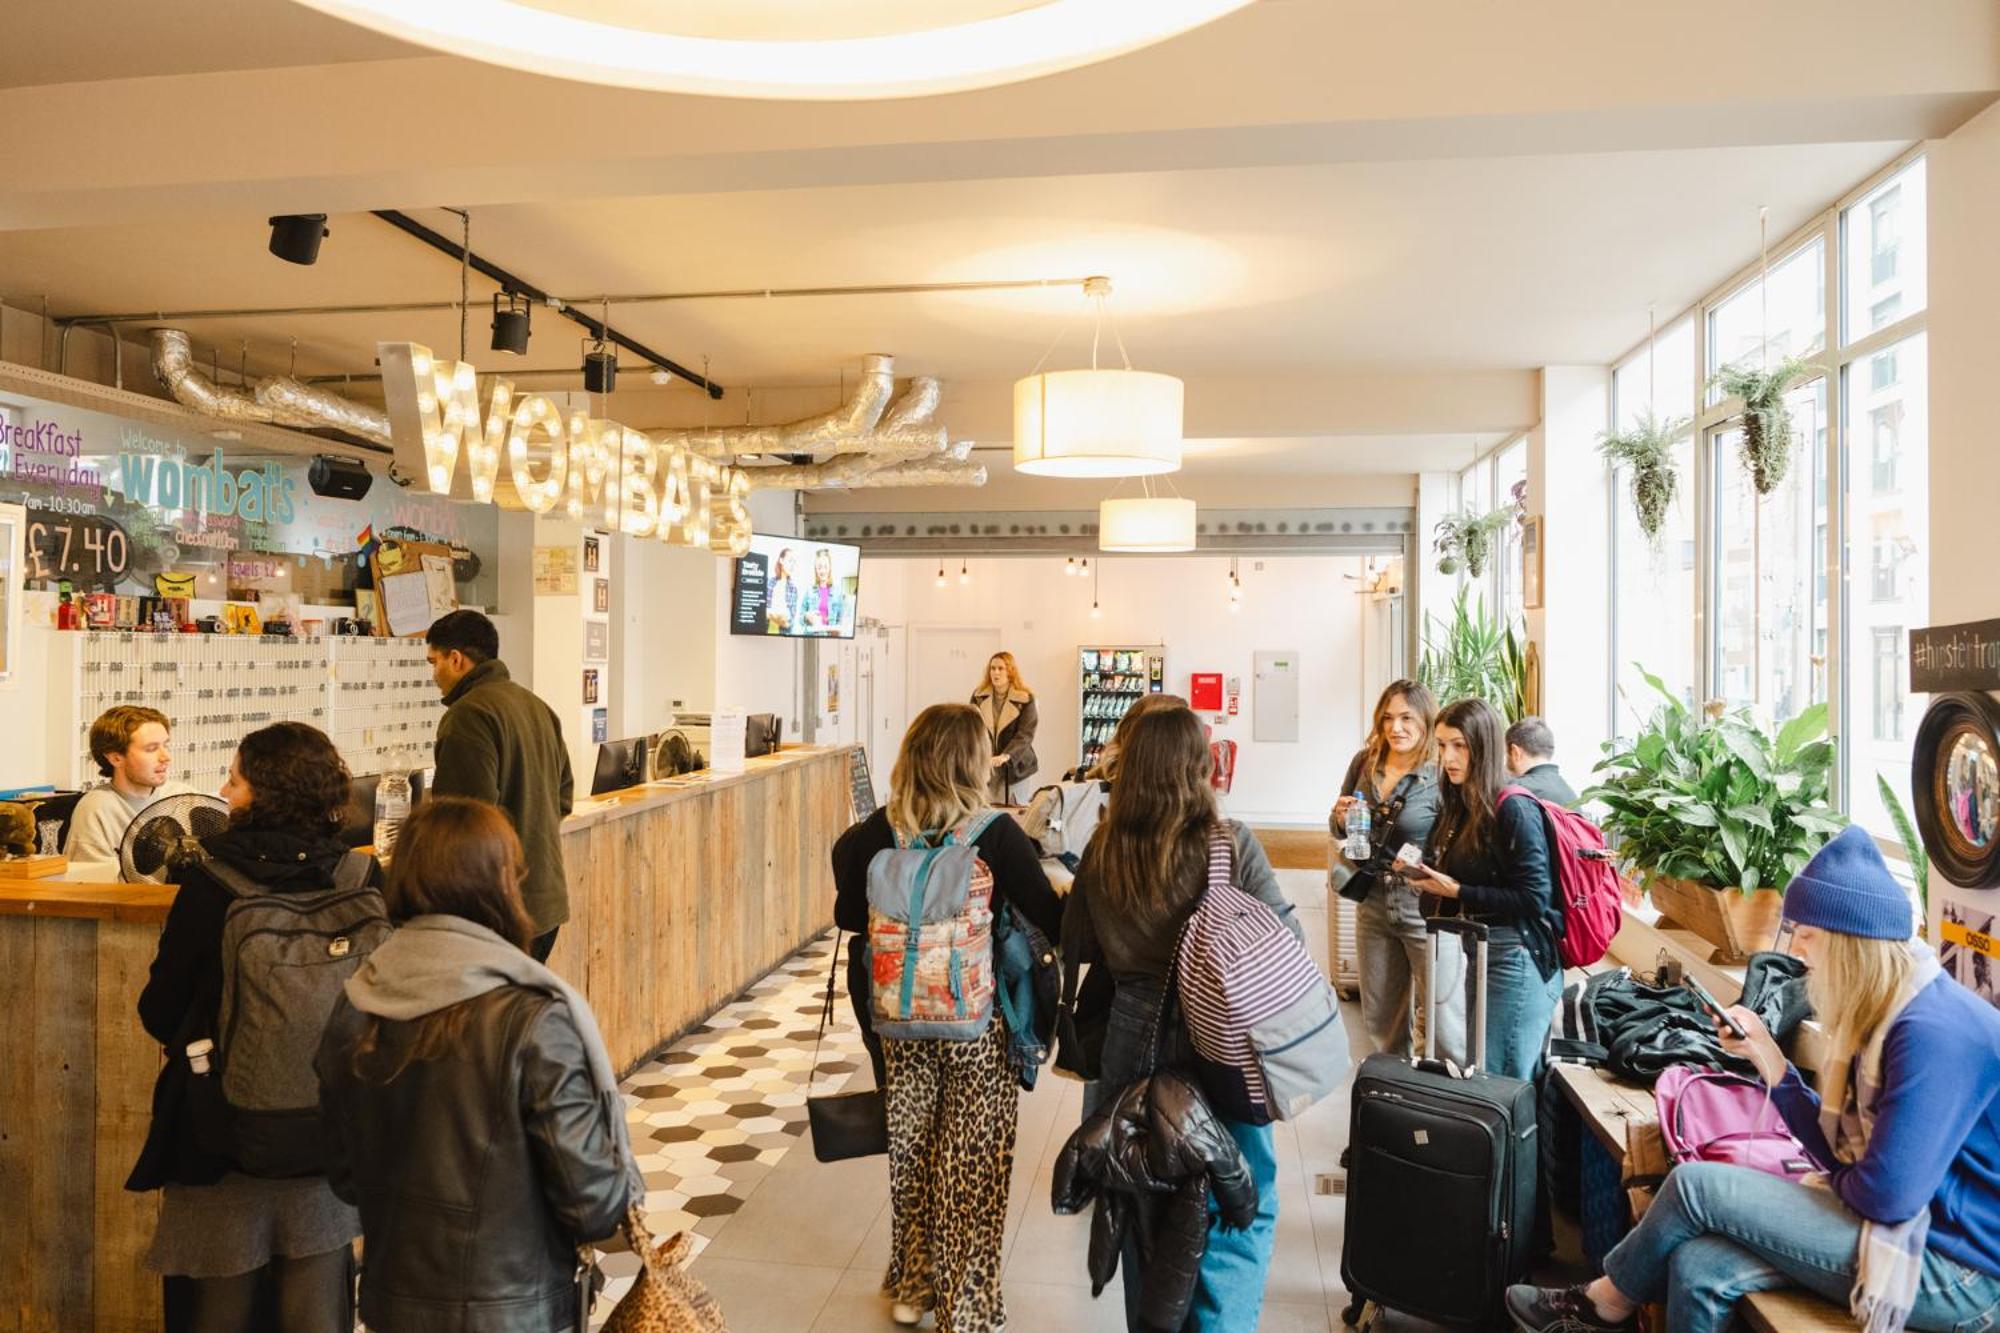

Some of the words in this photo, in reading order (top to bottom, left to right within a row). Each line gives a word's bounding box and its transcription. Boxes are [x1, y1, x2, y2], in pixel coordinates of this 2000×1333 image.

[119, 425, 170, 457] Welcome
[15, 453, 102, 500] Everyday
[119, 448, 296, 525] wombat's
[29, 522, 127, 578] £7.40
